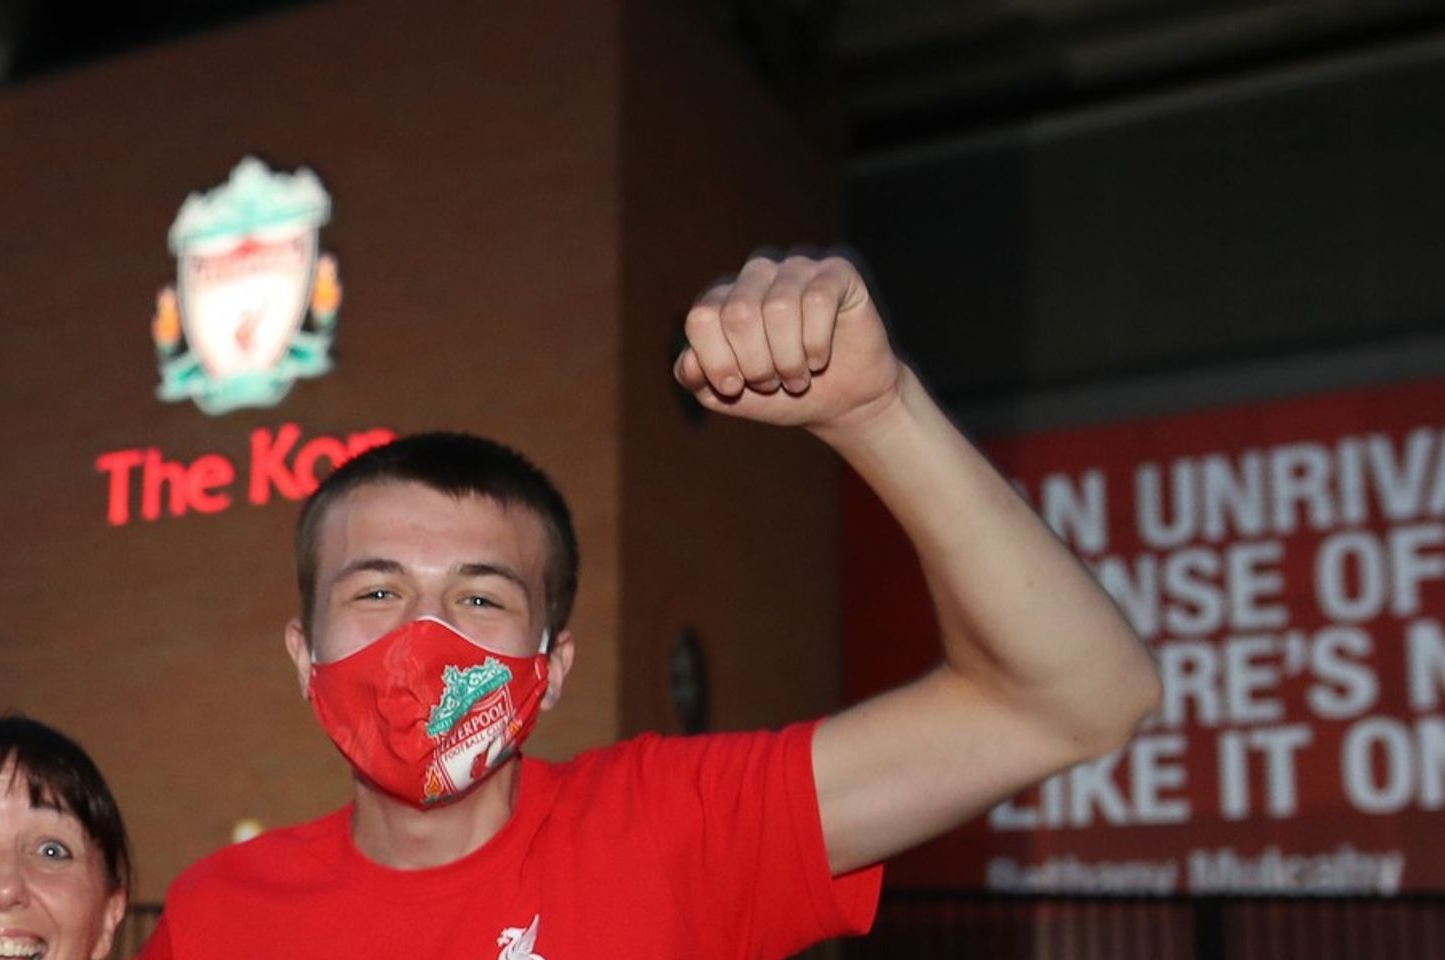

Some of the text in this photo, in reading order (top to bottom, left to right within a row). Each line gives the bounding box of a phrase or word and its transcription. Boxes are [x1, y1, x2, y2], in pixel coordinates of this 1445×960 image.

[95, 447, 236, 527] The
[1019, 468, 1108, 555] N
[1313, 522, 1445, 625] OF
[1155, 625, 1381, 730] RE'S
[1217, 725, 1313, 820] IT
